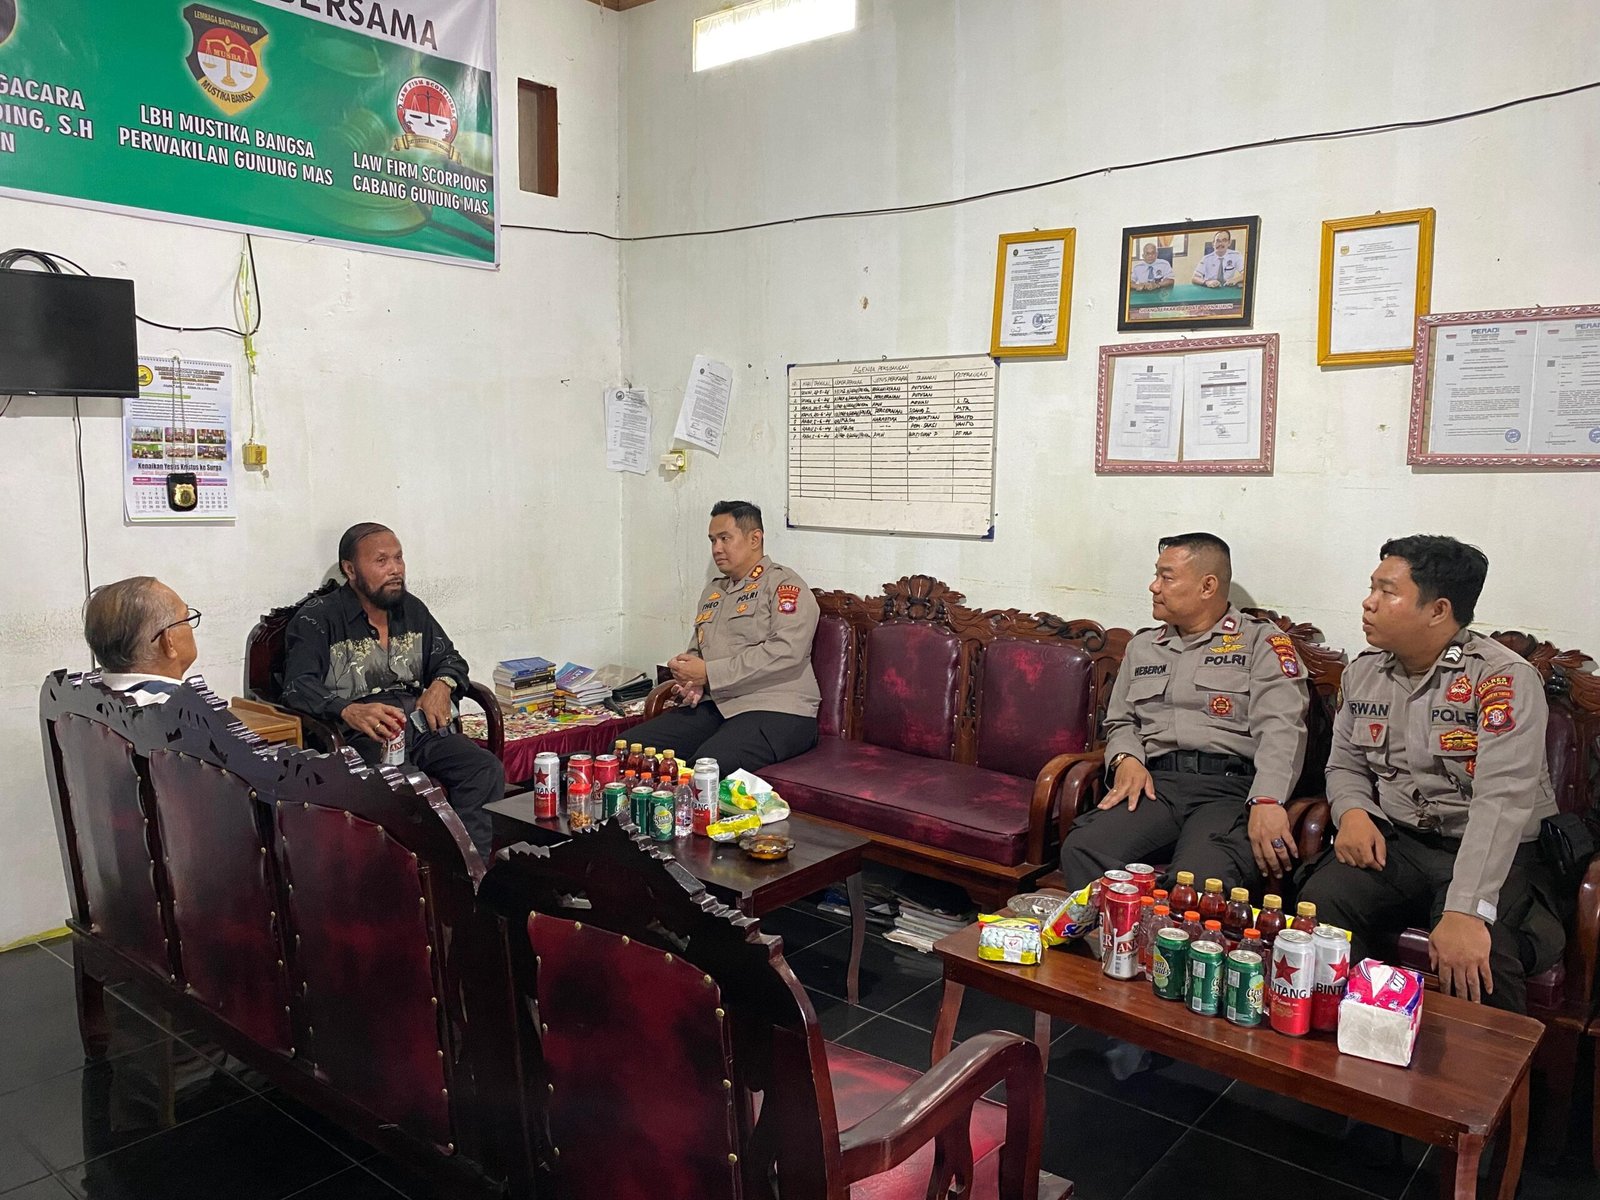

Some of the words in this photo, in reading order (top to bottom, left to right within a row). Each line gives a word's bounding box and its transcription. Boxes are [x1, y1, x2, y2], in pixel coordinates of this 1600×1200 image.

[201, 80, 230, 102] MUSTIKA
[231, 91, 256, 103] BANGSA
[0, 104, 51, 133] ING,
[58, 115, 93, 139] S.H
[140, 104, 172, 128] LBH
[179, 113, 250, 145] MUSTIKA
[255, 129, 315, 159] BANGSA
[119, 127, 229, 166] PERWAKILAN
[234, 151, 297, 178] GUNUNG
[302, 165, 333, 186] MAS
[353, 152, 382, 172] LAW
[387, 159, 418, 179] FIRM
[422, 166, 487, 193] SCORPIONS
[353, 175, 406, 199] CABANG
[411, 186, 460, 210] GUNUNG
[464, 197, 489, 215] MAS
[1471, 327, 1500, 335] PERADI
[138, 462, 163, 470] Kenaikan
[207, 464, 222, 472] Surga
[736, 591, 759, 604] POLRI
[1204, 655, 1246, 666] POLRI
